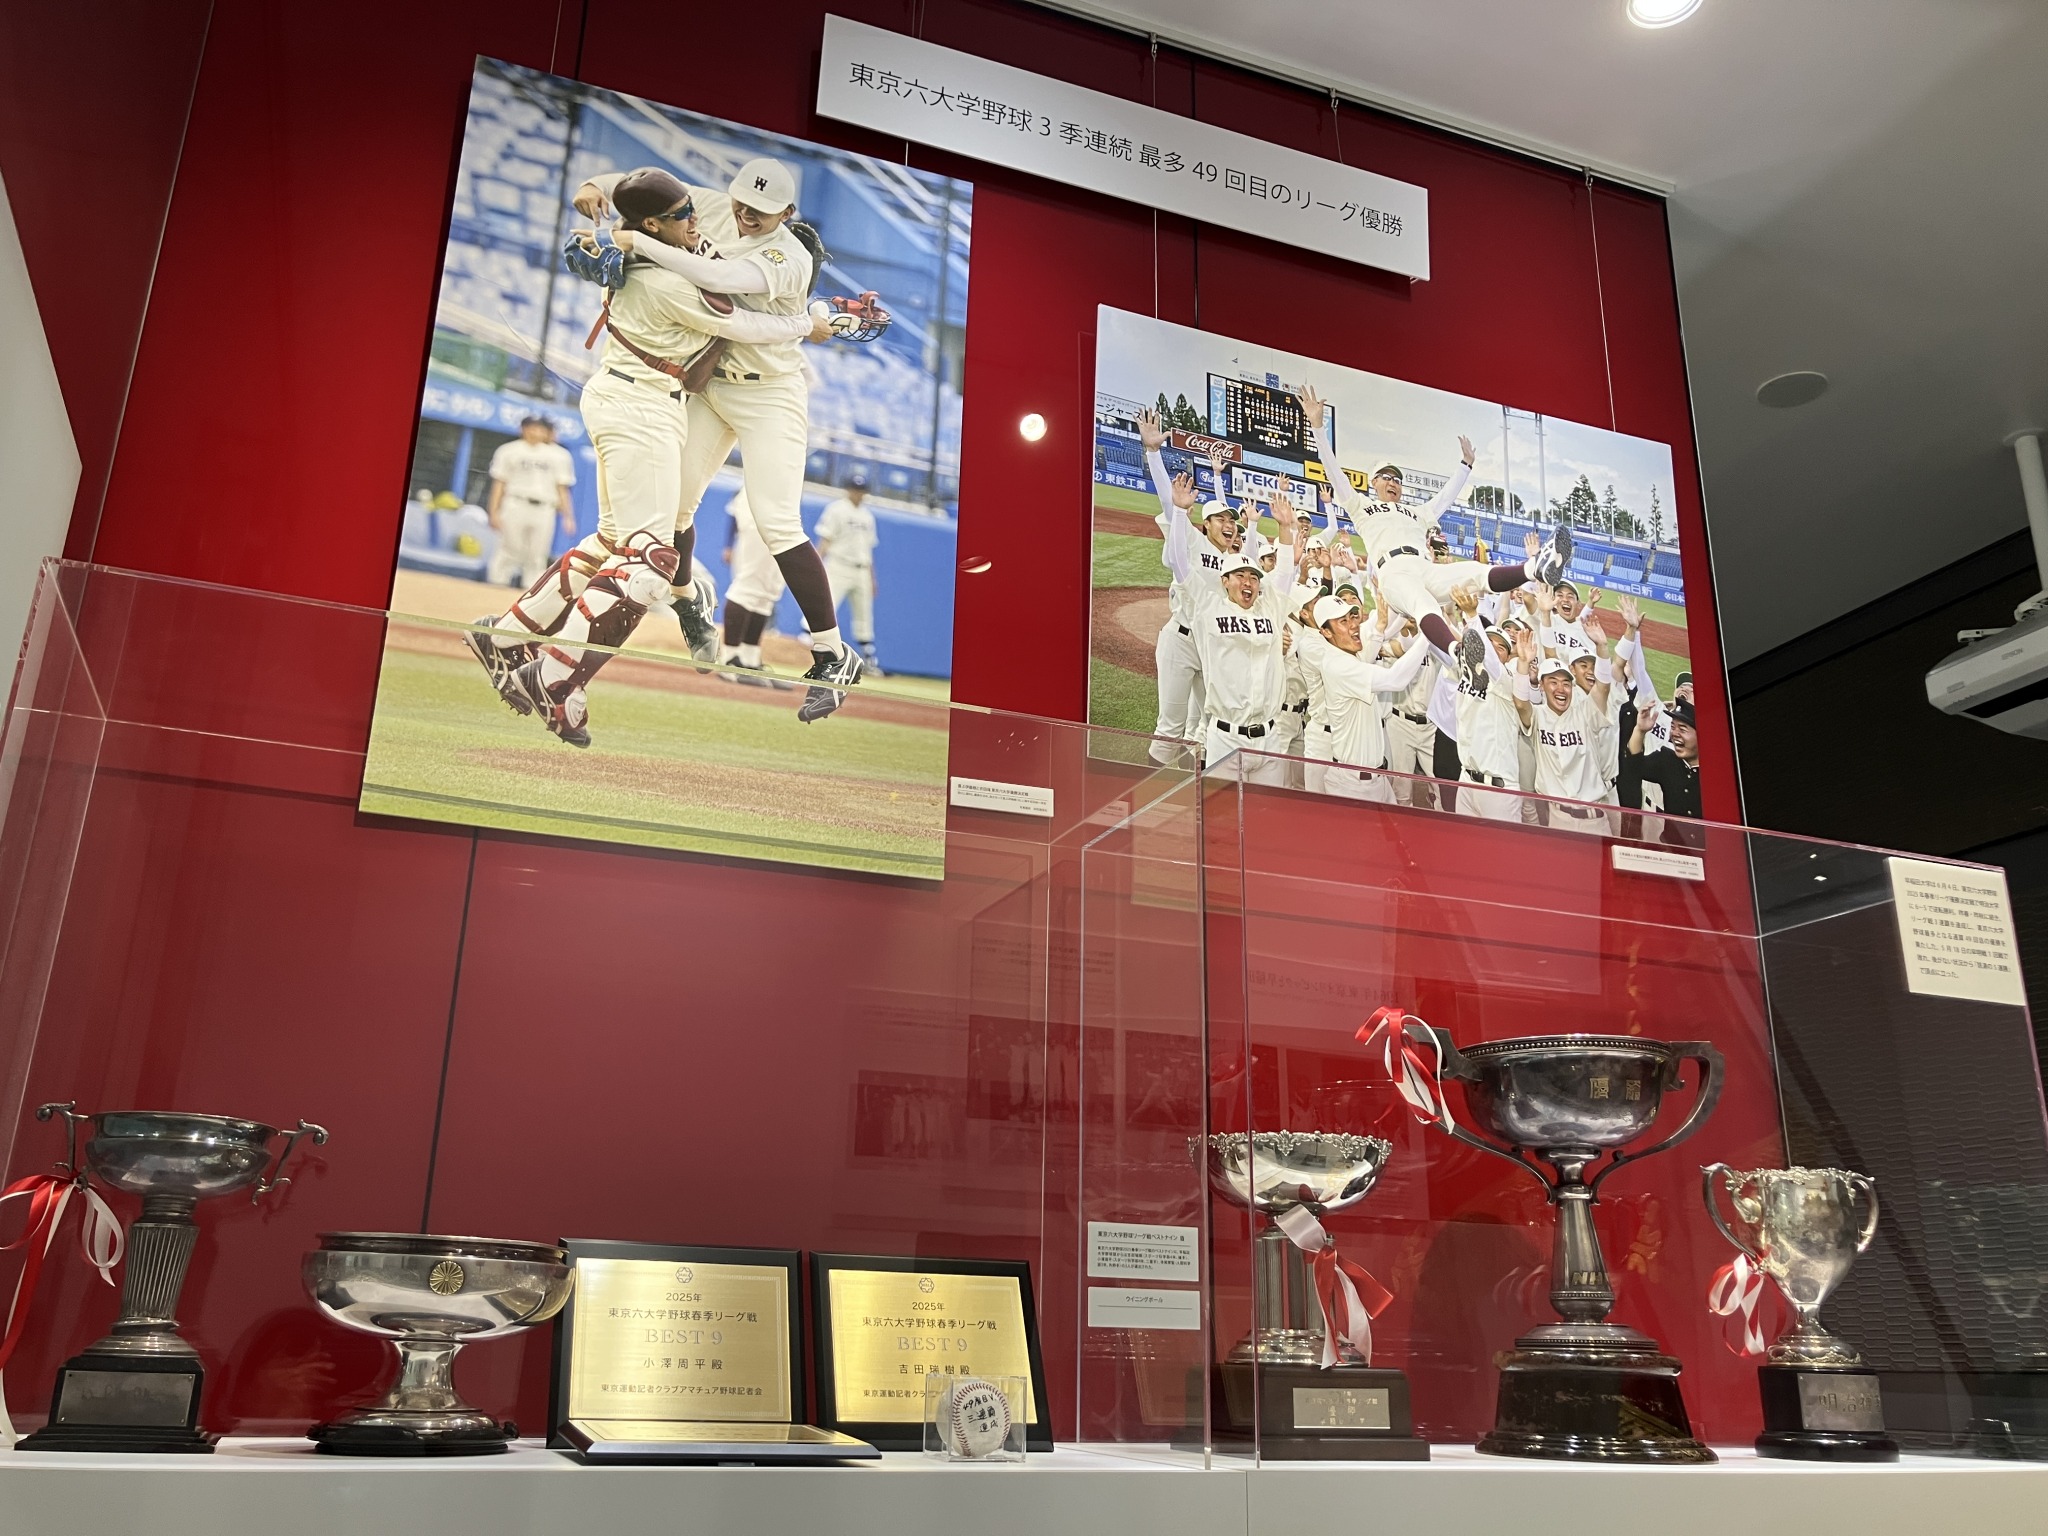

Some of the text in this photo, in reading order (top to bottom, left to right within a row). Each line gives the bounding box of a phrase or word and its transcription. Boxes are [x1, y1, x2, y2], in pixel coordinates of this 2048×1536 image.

[1105, 473, 1147, 490] 東鉄工業
[665, 1292, 702, 1303] 2025年
[911, 1301, 945, 1311] 2025年
[607, 1307, 758, 1323] 東京六大学野球春季リーグ戦
[861, 1316, 998, 1331] 東京六大学野球春季リーグ戦
[644, 1328, 723, 1345] BEST 9
[897, 1336, 968, 1352] BEST 9
